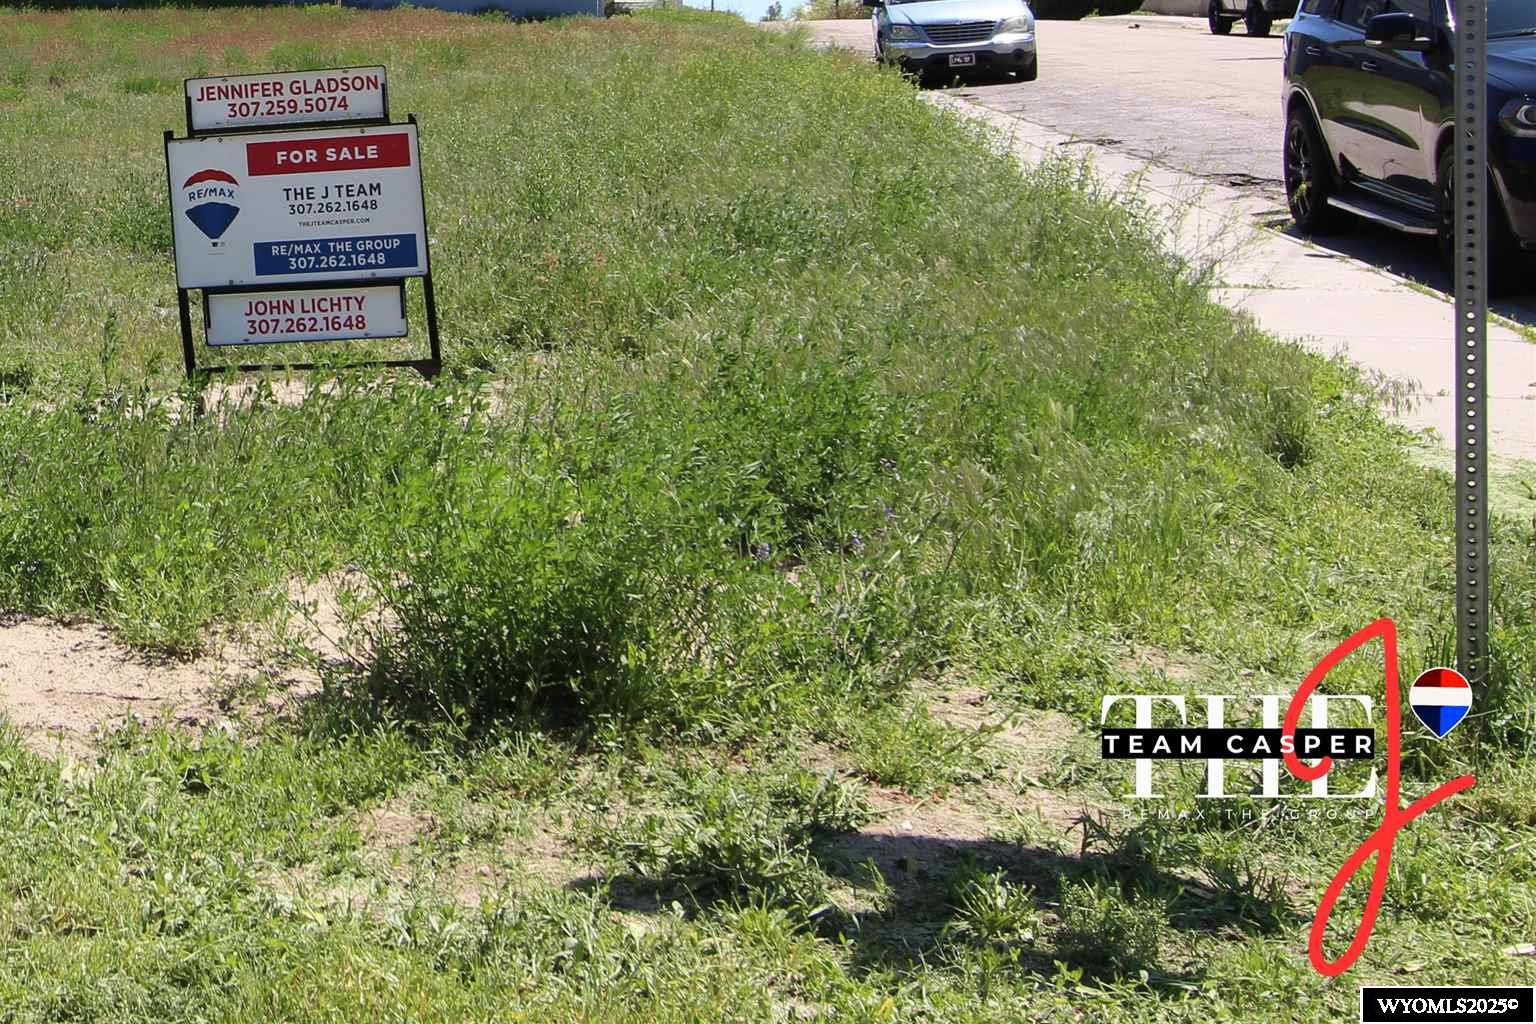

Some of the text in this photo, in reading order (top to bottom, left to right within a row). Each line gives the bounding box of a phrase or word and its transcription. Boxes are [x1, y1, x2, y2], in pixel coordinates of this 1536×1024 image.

[196, 75, 379, 102] JENNIFER GLADSON
[227, 95, 349, 118] 307.259.5074
[276, 144, 379, 165] FOR SALE
[188, 187, 235, 202] RE/MAX
[283, 182, 382, 201] THE J TEAM
[288, 199, 378, 215] 307.262.1648
[271, 238, 401, 256] RE/MAX THE GROUP
[288, 253, 386, 270] 307.262.1648
[244, 295, 365, 316] JOHN LICHTY
[247, 314, 366, 335] 307.262.1648
